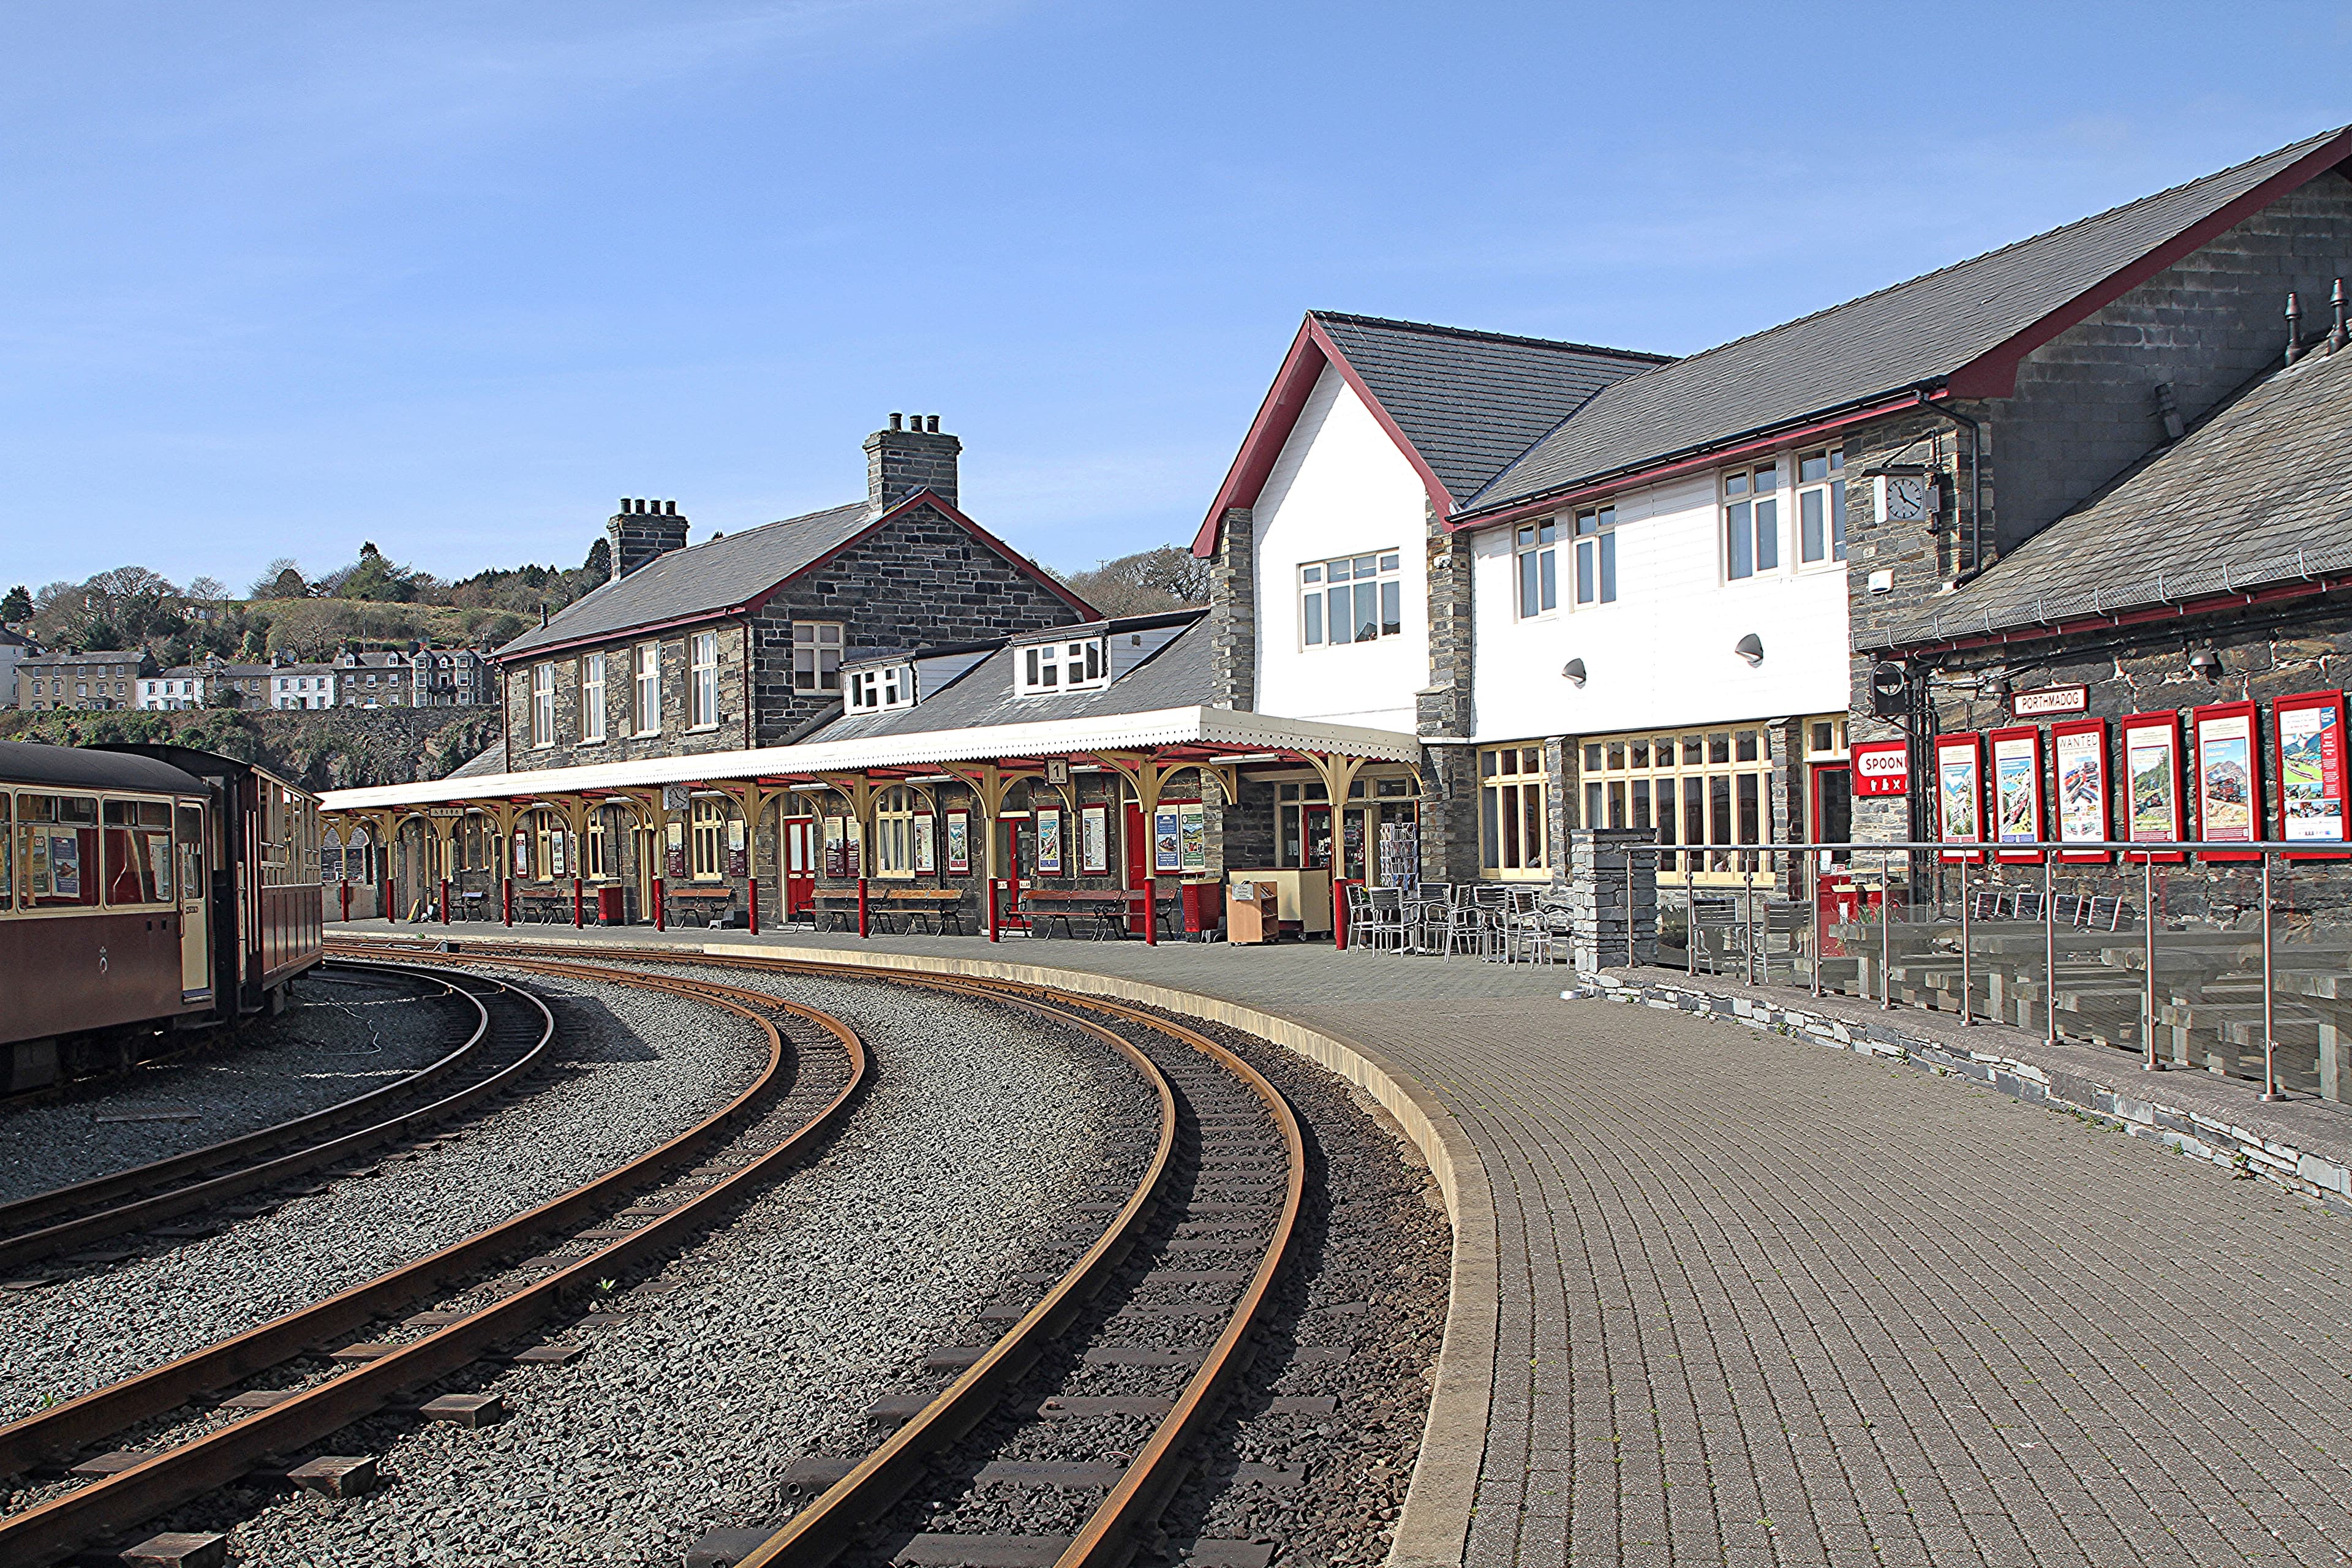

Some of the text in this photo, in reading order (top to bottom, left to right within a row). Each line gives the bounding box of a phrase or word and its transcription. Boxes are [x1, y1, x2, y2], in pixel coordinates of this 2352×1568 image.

[2022, 692, 2079, 710] PORTHMADOG
[2059, 735, 2098, 748] WANTED
[1054, 764, 1060, 777] 1
[1866, 756, 1907, 771] SPOON
